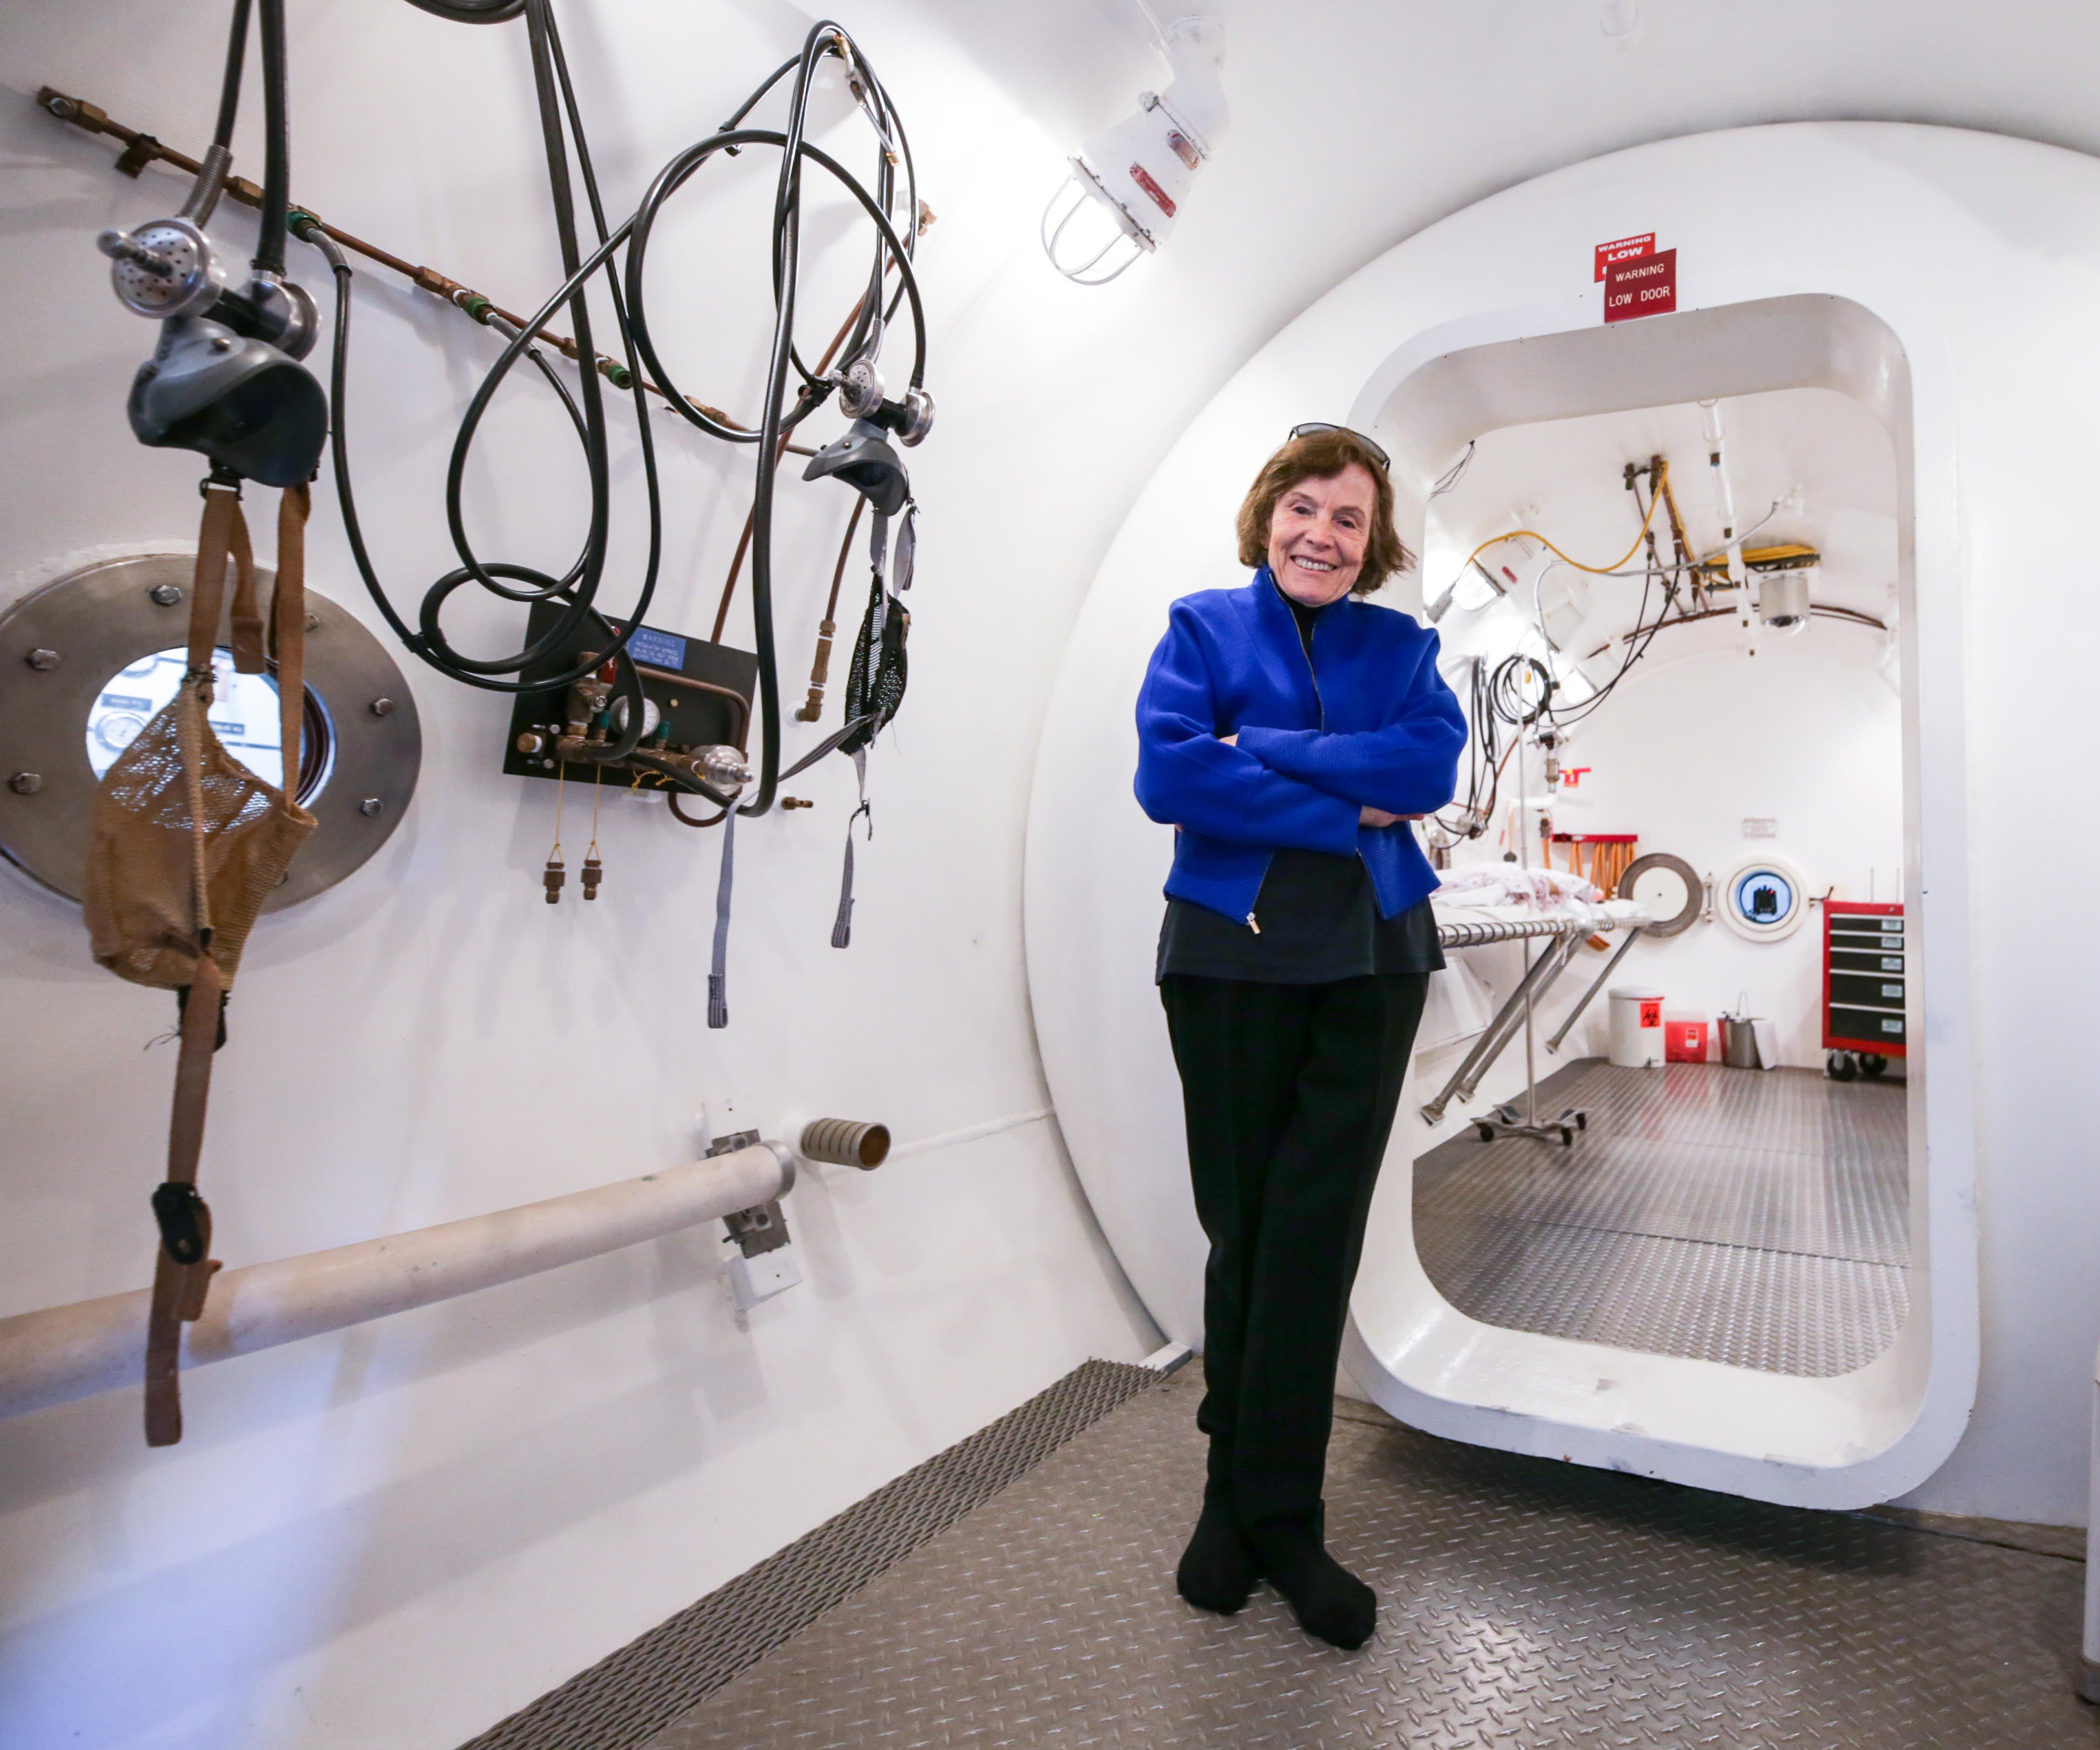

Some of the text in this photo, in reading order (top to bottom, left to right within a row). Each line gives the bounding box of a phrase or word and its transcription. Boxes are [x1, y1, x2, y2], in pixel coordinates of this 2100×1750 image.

[1598, 235, 1651, 252] WARNING
[1608, 246, 1643, 261] LOW
[1616, 263, 1664, 282] WARNING
[1609, 286, 1670, 307] LOW DOOR
